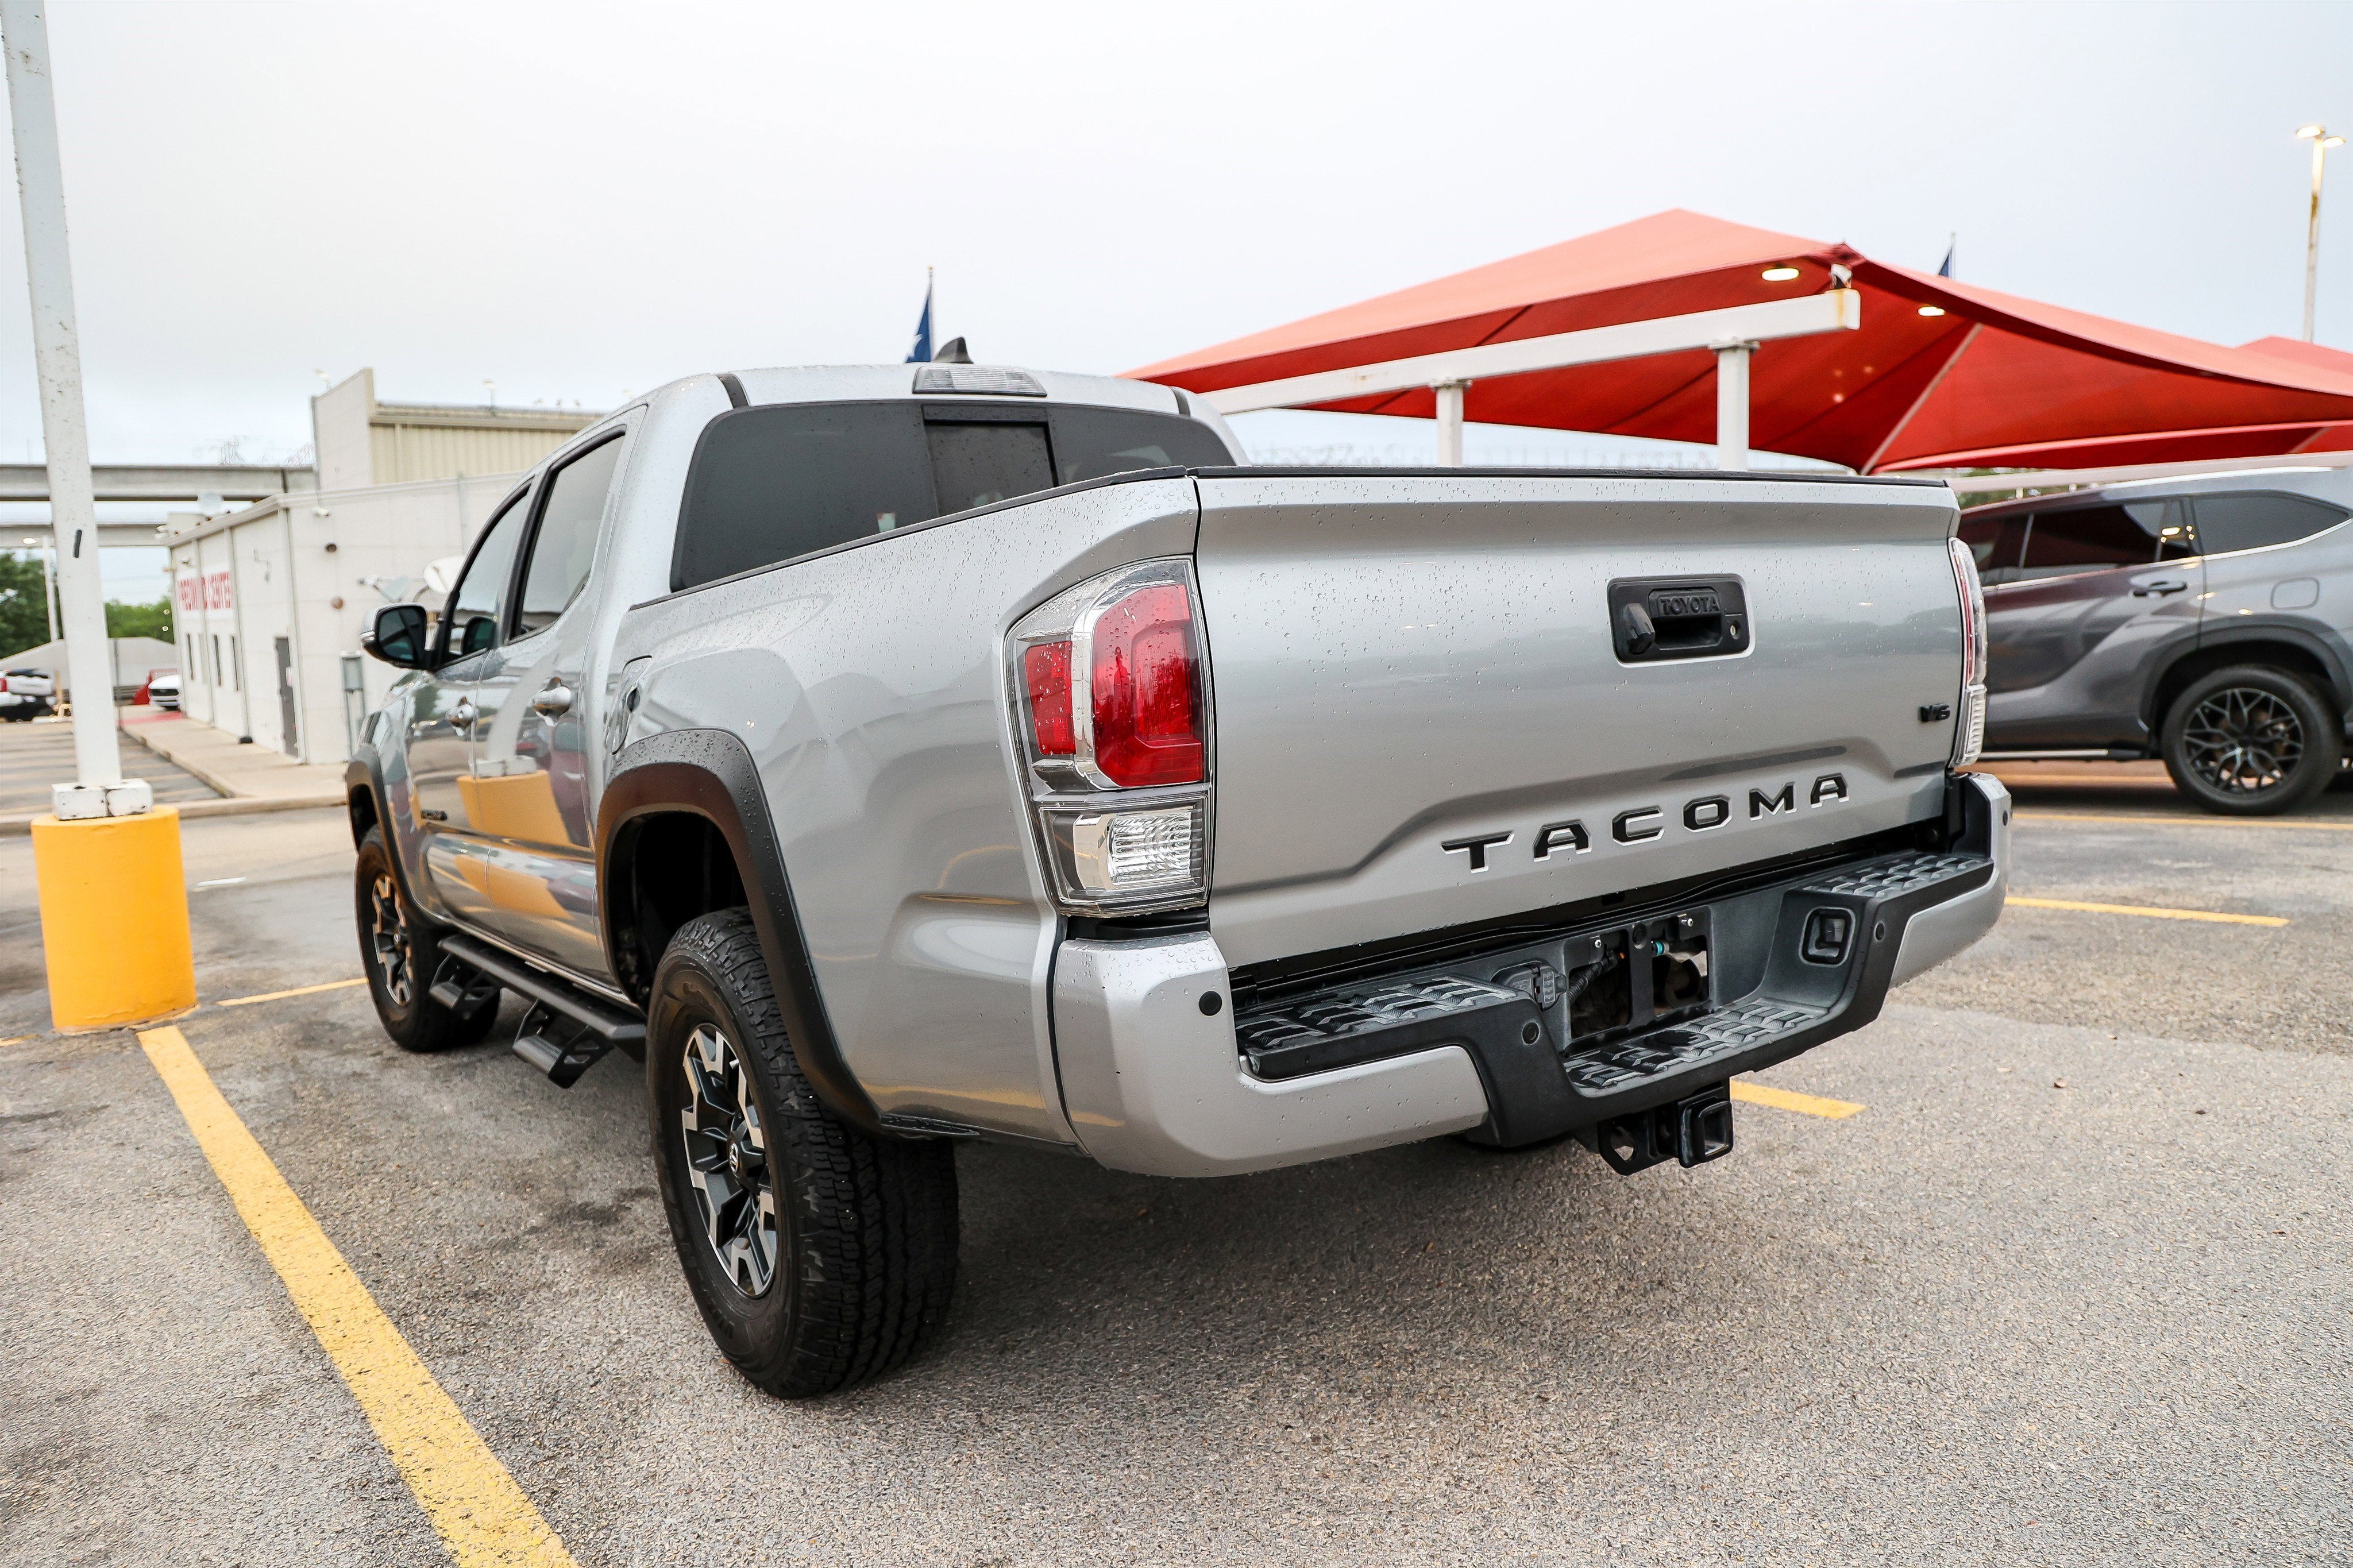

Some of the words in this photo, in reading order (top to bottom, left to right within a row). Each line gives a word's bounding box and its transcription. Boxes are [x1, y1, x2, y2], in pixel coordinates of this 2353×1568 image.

[1658, 595, 1721, 616] TOYOTA
[1918, 702, 1951, 723] V6
[1440, 773, 1850, 873] TACOMA
